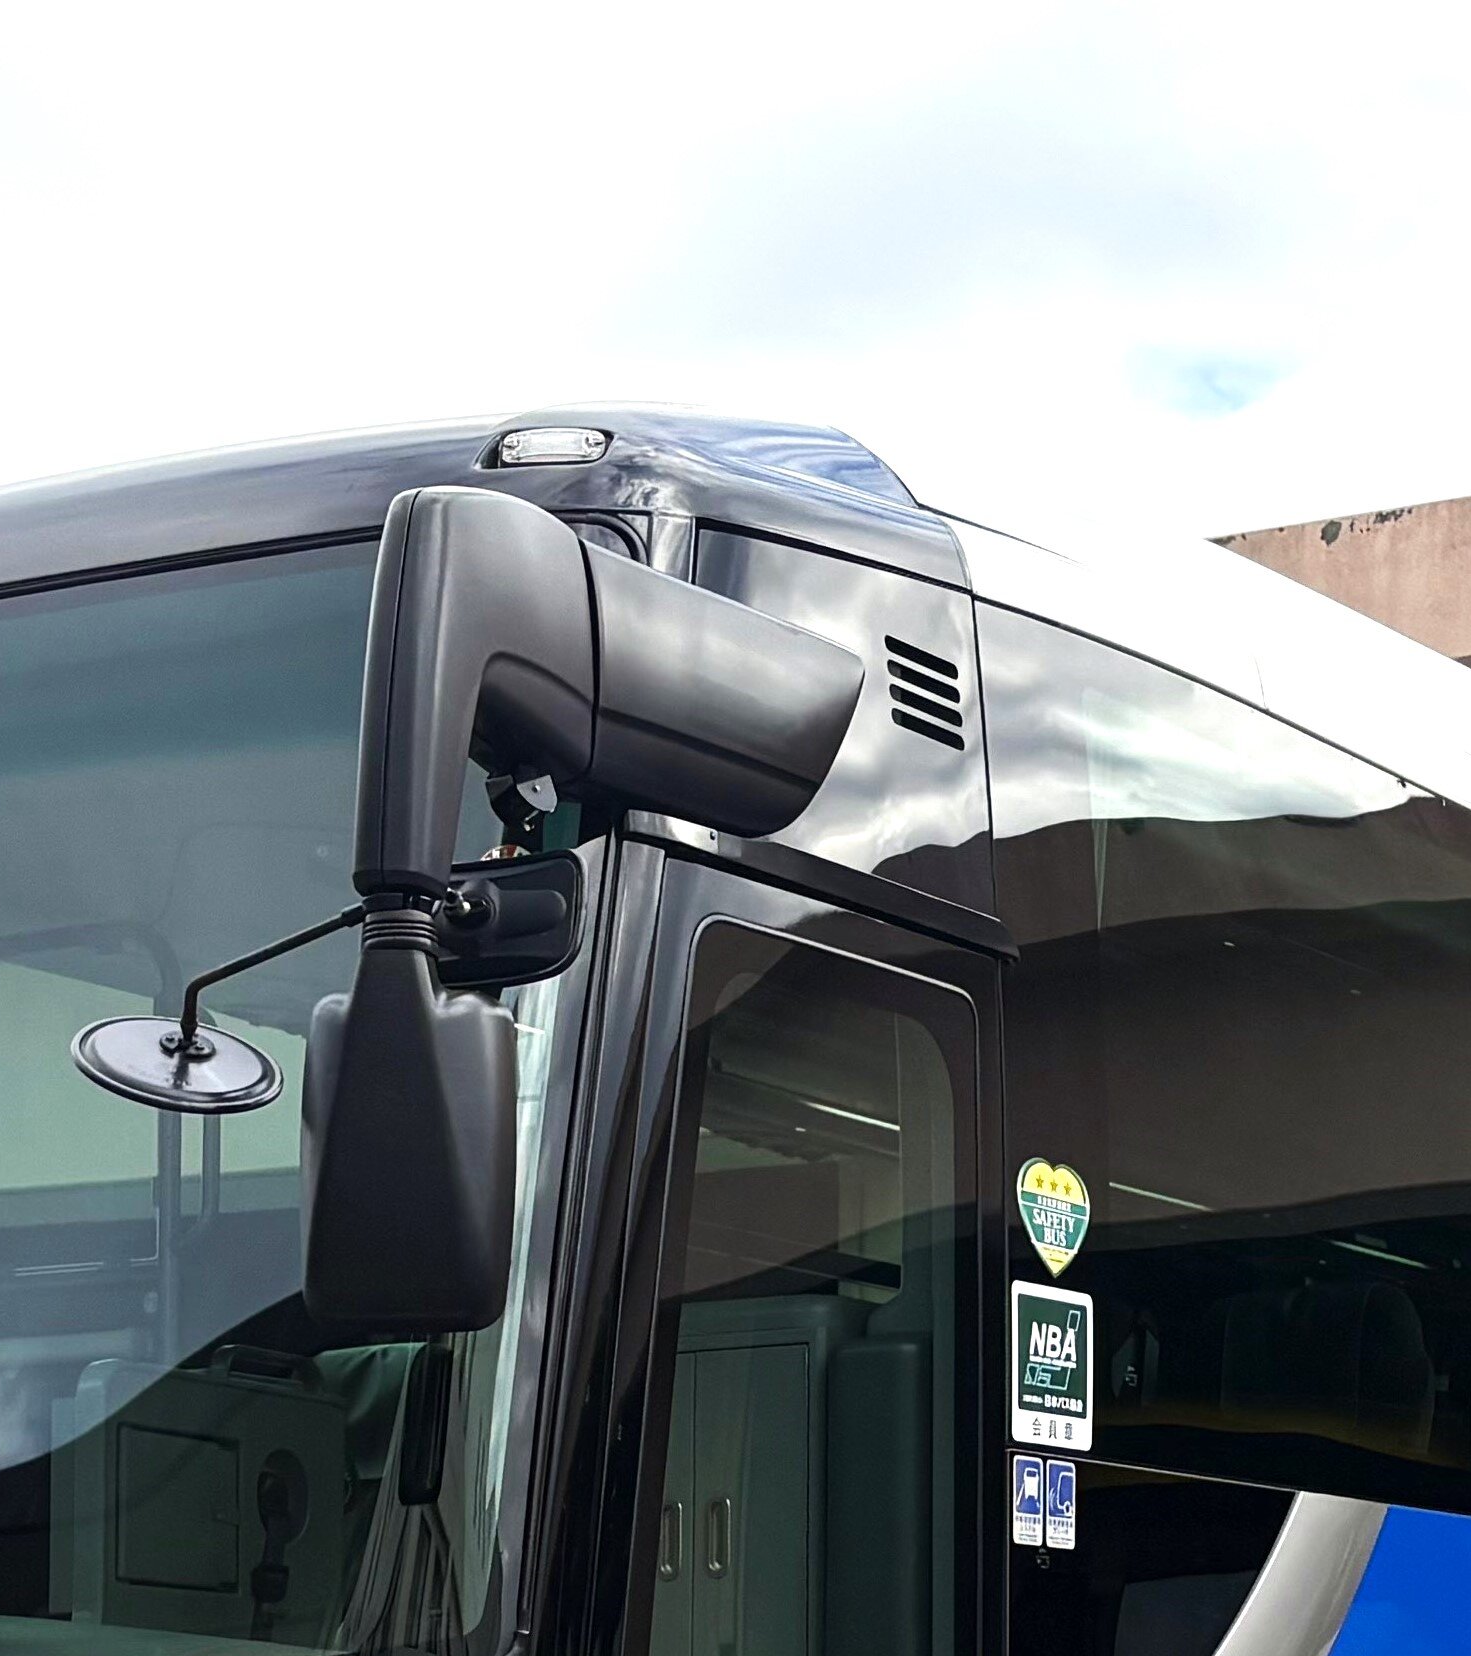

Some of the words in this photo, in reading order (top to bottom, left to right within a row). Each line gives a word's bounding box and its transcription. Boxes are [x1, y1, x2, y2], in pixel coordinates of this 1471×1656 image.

[1032, 1207, 1076, 1233] SAFETY
[1044, 1227, 1067, 1247] BUS
[1029, 1321, 1077, 1362] NBA
